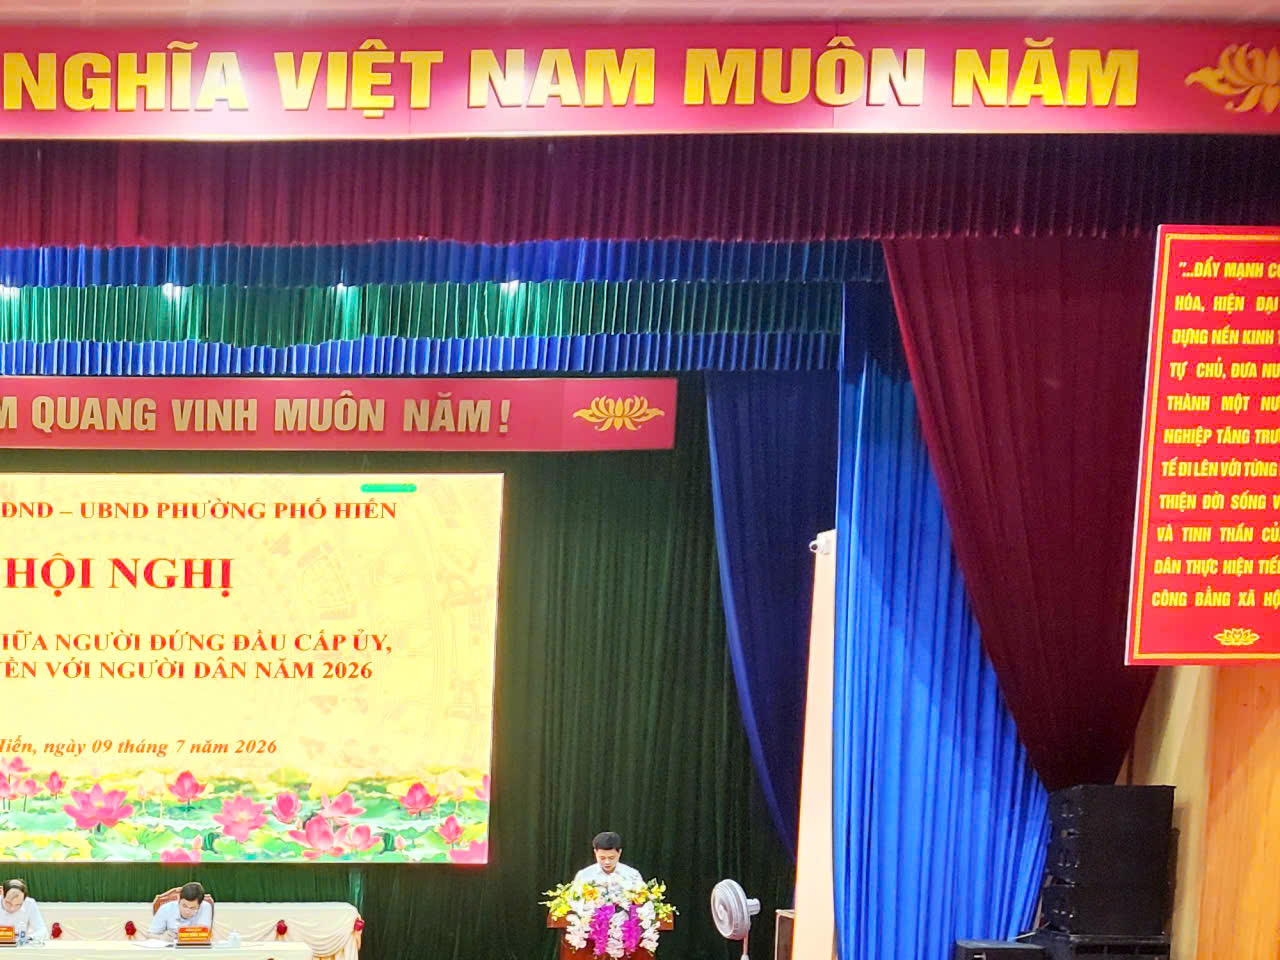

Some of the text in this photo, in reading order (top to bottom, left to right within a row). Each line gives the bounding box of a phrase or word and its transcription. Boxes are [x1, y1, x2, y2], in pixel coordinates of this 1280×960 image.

[3, 41, 251, 111] NGHĨA
[273, 40, 442, 118] VIỆT
[467, 47, 654, 108] NAM
[684, 37, 925, 108] MUÔN
[953, 38, 1139, 107] NĂM
[1224, 262, 1264, 280] MẠNH
[1175, 292, 1205, 312] HÓA,
[1213, 292, 1245, 315] HIỆN
[1172, 328, 1208, 347] DỰNG
[1242, 330, 1274, 344] KINH
[1170, 361, 1188, 381] TỰ
[1196, 356, 1226, 379] CHỦ,
[32, 395, 156, 436] QUANG
[172, 397, 257, 433] VINH
[273, 390, 385, 433] MUÔN
[1167, 393, 1210, 411] THÀNH
[1221, 393, 1250, 414] MỘT
[1164, 425, 1212, 447] NGHIỆP
[1162, 456, 1178, 477] TẾ
[1194, 459, 1218, 477] LÊN
[1221, 458, 1242, 477] VỚI
[80, 502, 149, 519] UBND
[157, 498, 266, 519] PHƯỜNG
[274, 498, 327, 519] PHỐ
[334, 498, 398, 519] HIẾN
[1159, 491, 1197, 512] THIỆN
[1231, 490, 1267, 510] SỐNG
[1157, 523, 1173, 542] VÀ
[1182, 527, 1211, 542] TINH
[1262, 521, 1280, 542] CỦ
[4, 552, 234, 598] HỘI NGHỊ
[1154, 556, 1182, 574] DÂN
[1186, 558, 1218, 577] THỰC
[1223, 557, 1254, 577] HIỆN
[1152, 589, 1188, 607] CÔNG
[1238, 589, 1256, 607] XÃ
[1263, 589, 1280, 610] HỘ
[55, 629, 140, 651] NGƯỜI
[149, 629, 225, 651] ĐỨNG
[233, 629, 287, 651] ĐẦU
[294, 629, 346, 651] CẤP
[353, 629, 392, 655] ỦY,
[45, 657, 92, 678] VỚI
[100, 657, 185, 679] NGƯỜI
[194, 656, 247, 679] DÂN
[256, 657, 315, 679] NĂM
[322, 661, 373, 679] 2026
[43, 739, 86, 757] ngày
[92, 739, 113, 753] 09
[118, 739, 169, 757] tháng
[177, 739, 185, 753] 7
[190, 739, 229, 753] năm
[234, 739, 277, 754] 2026
